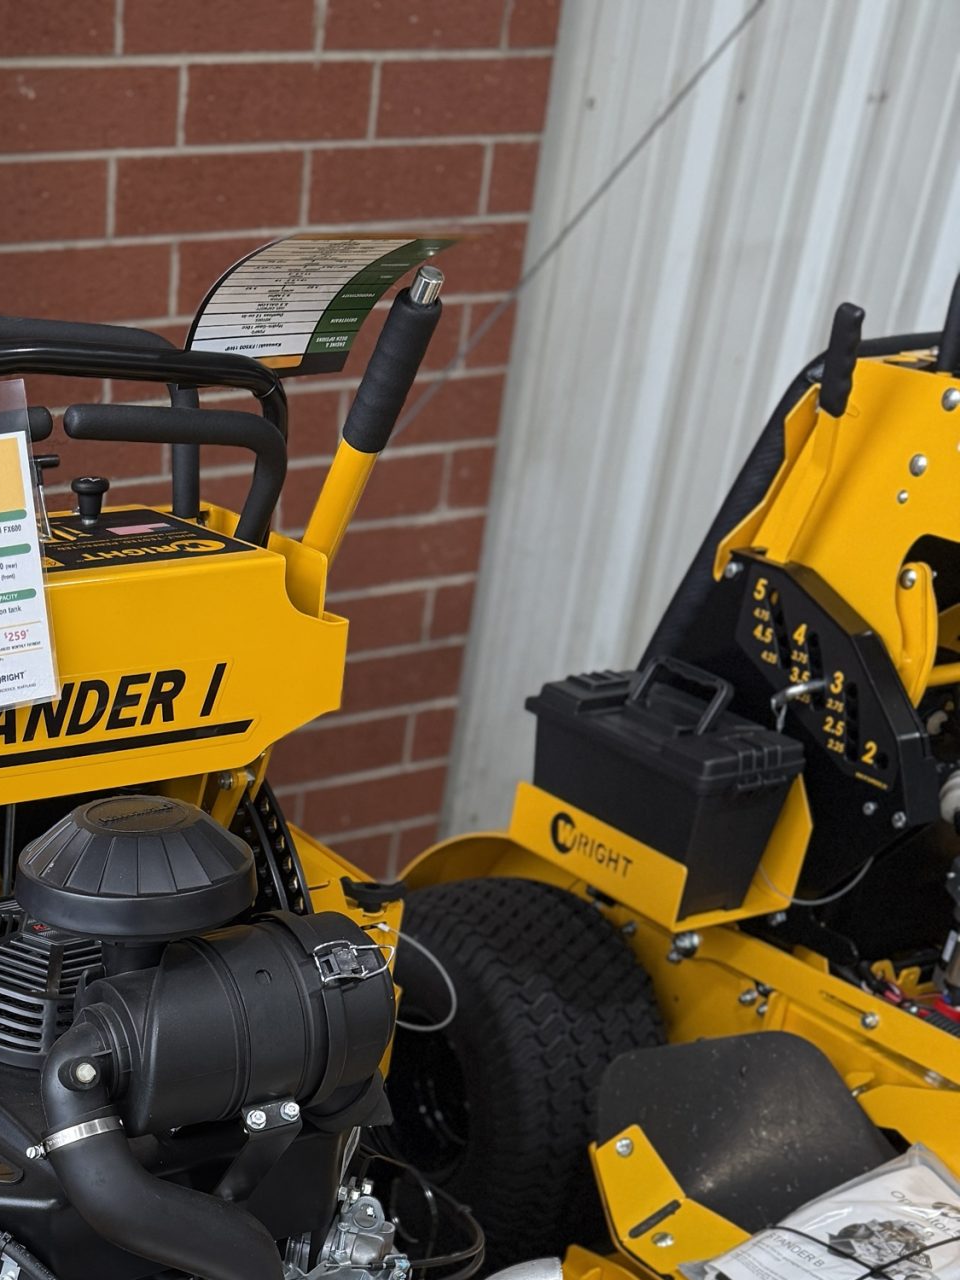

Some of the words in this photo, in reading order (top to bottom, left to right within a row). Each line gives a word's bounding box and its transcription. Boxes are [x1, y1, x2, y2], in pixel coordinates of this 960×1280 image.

[3, 523, 21, 533] FX600
[753, 577, 768, 599] 5
[7, 604, 21, 613] tank
[753, 623, 773, 642] 4.5
[792, 623, 807, 645] 4
[830, 671, 844, 693] 3
[822, 715, 844, 735] 2.5
[861, 740, 876, 764] 2
